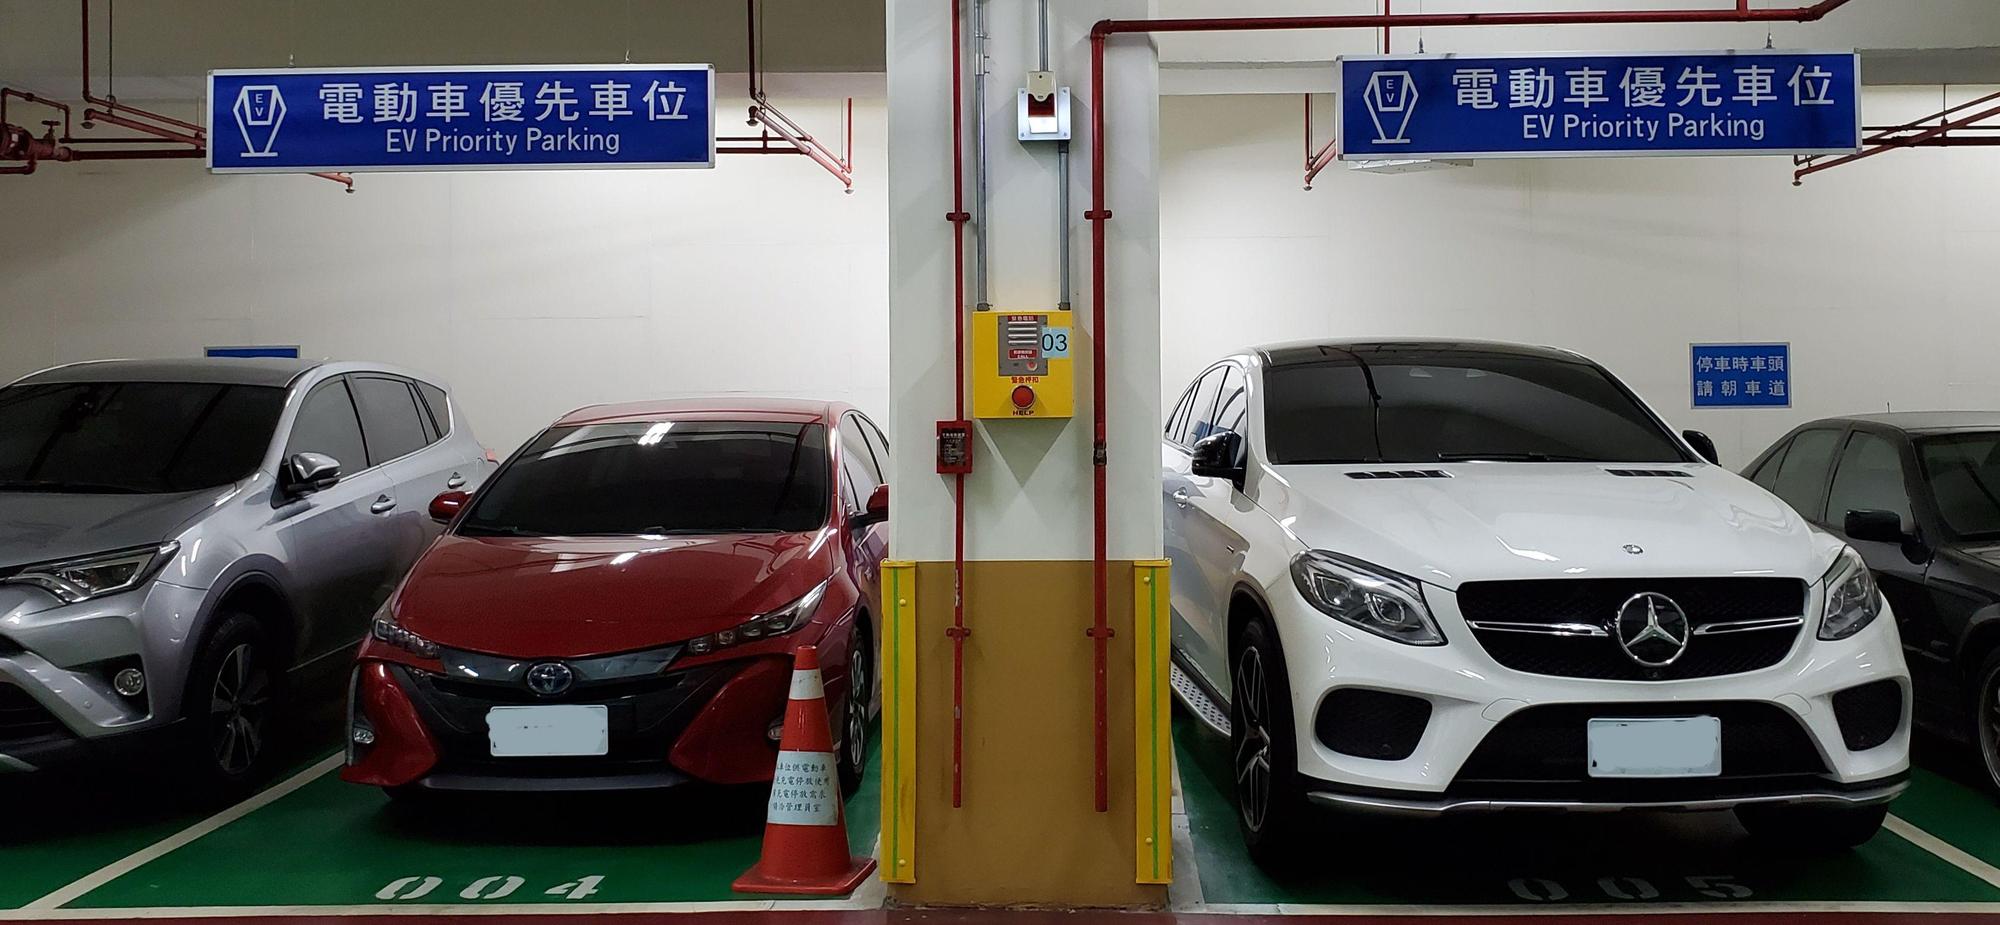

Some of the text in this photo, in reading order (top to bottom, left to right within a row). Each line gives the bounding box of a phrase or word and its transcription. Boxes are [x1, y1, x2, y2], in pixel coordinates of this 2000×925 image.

[1452, 65, 1835, 110] 電動車優先車位
[319, 80, 689, 123] 電動車優先車位
[1523, 112, 1765, 141] EV Priority Parking
[386, 127, 620, 156] EV Priority Parking
[1042, 333, 1067, 352] 03
[1696, 355, 1784, 372] 停車時車頭
[1696, 380, 1785, 397] 請朝車道
[375, 875, 606, 900] 004
[1507, 875, 1754, 901] 005
